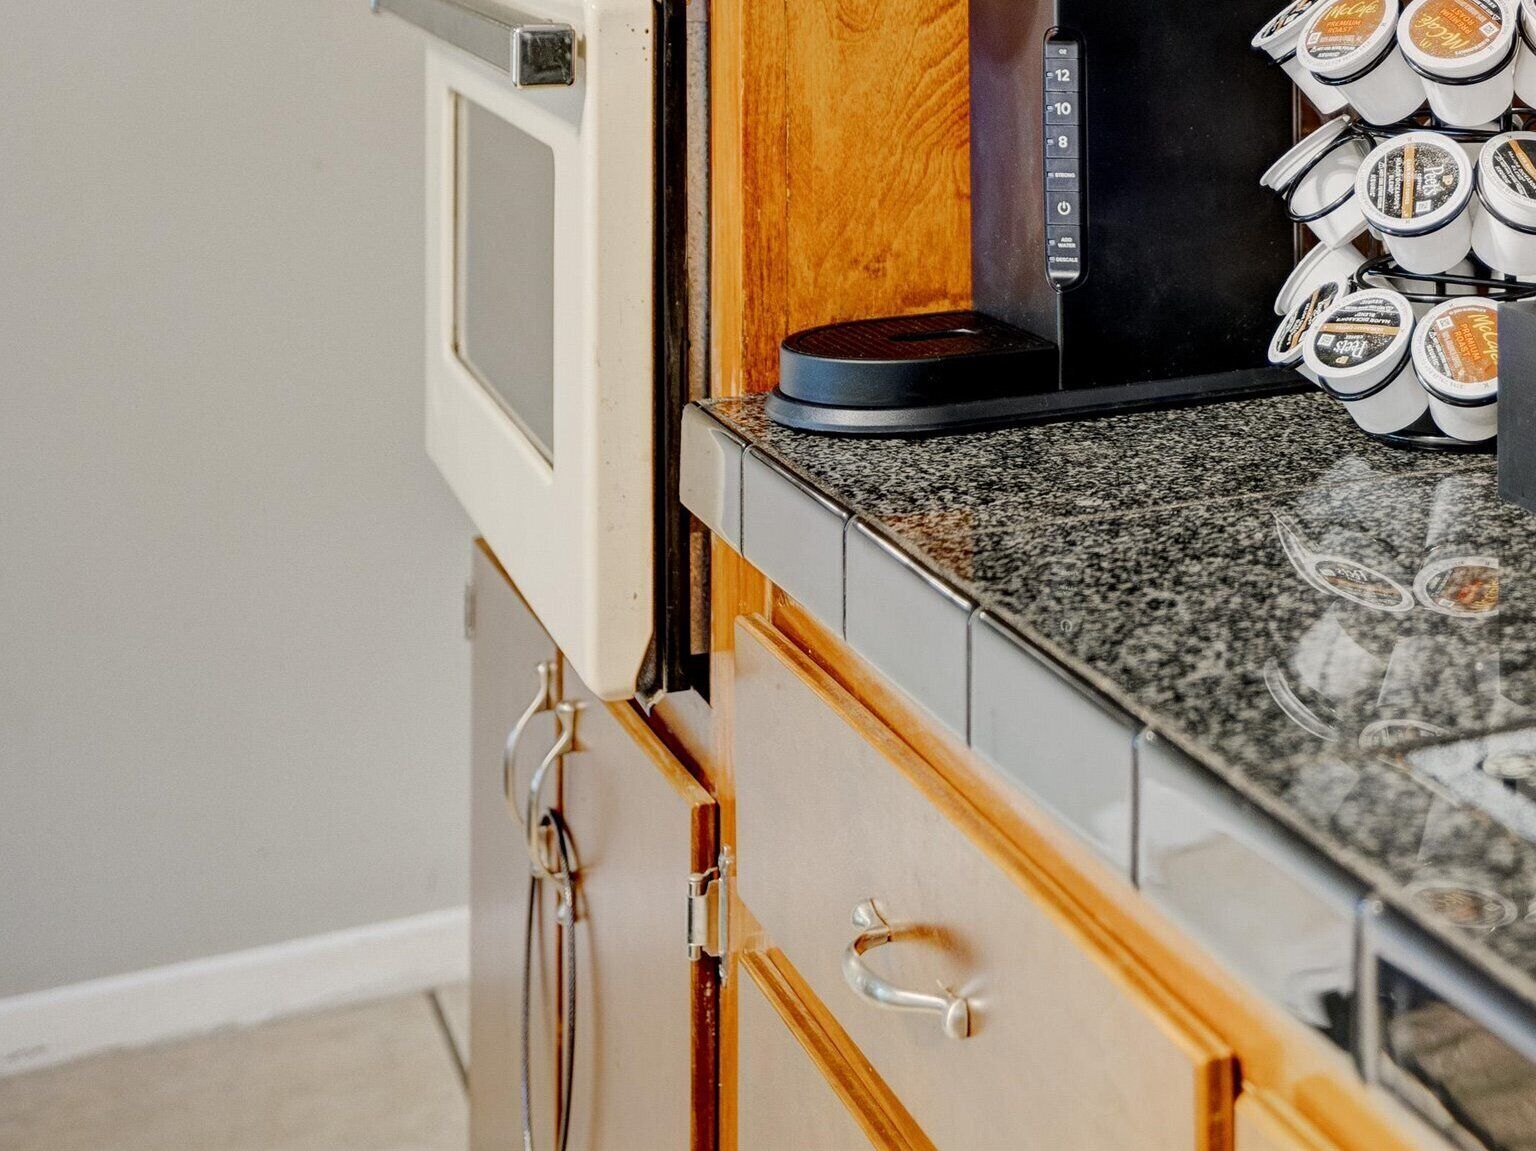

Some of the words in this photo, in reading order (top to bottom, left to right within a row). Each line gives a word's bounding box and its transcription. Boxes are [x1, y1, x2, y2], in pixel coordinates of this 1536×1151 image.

[1055, 68, 1070, 82] 12
[1054, 101, 1072, 115] 10
[1058, 135, 1068, 148] 8
[1332, 340, 1368, 358] Peet's
[1454, 330, 1472, 358] ROAST
[1461, 322, 1482, 362] PREMIUM
